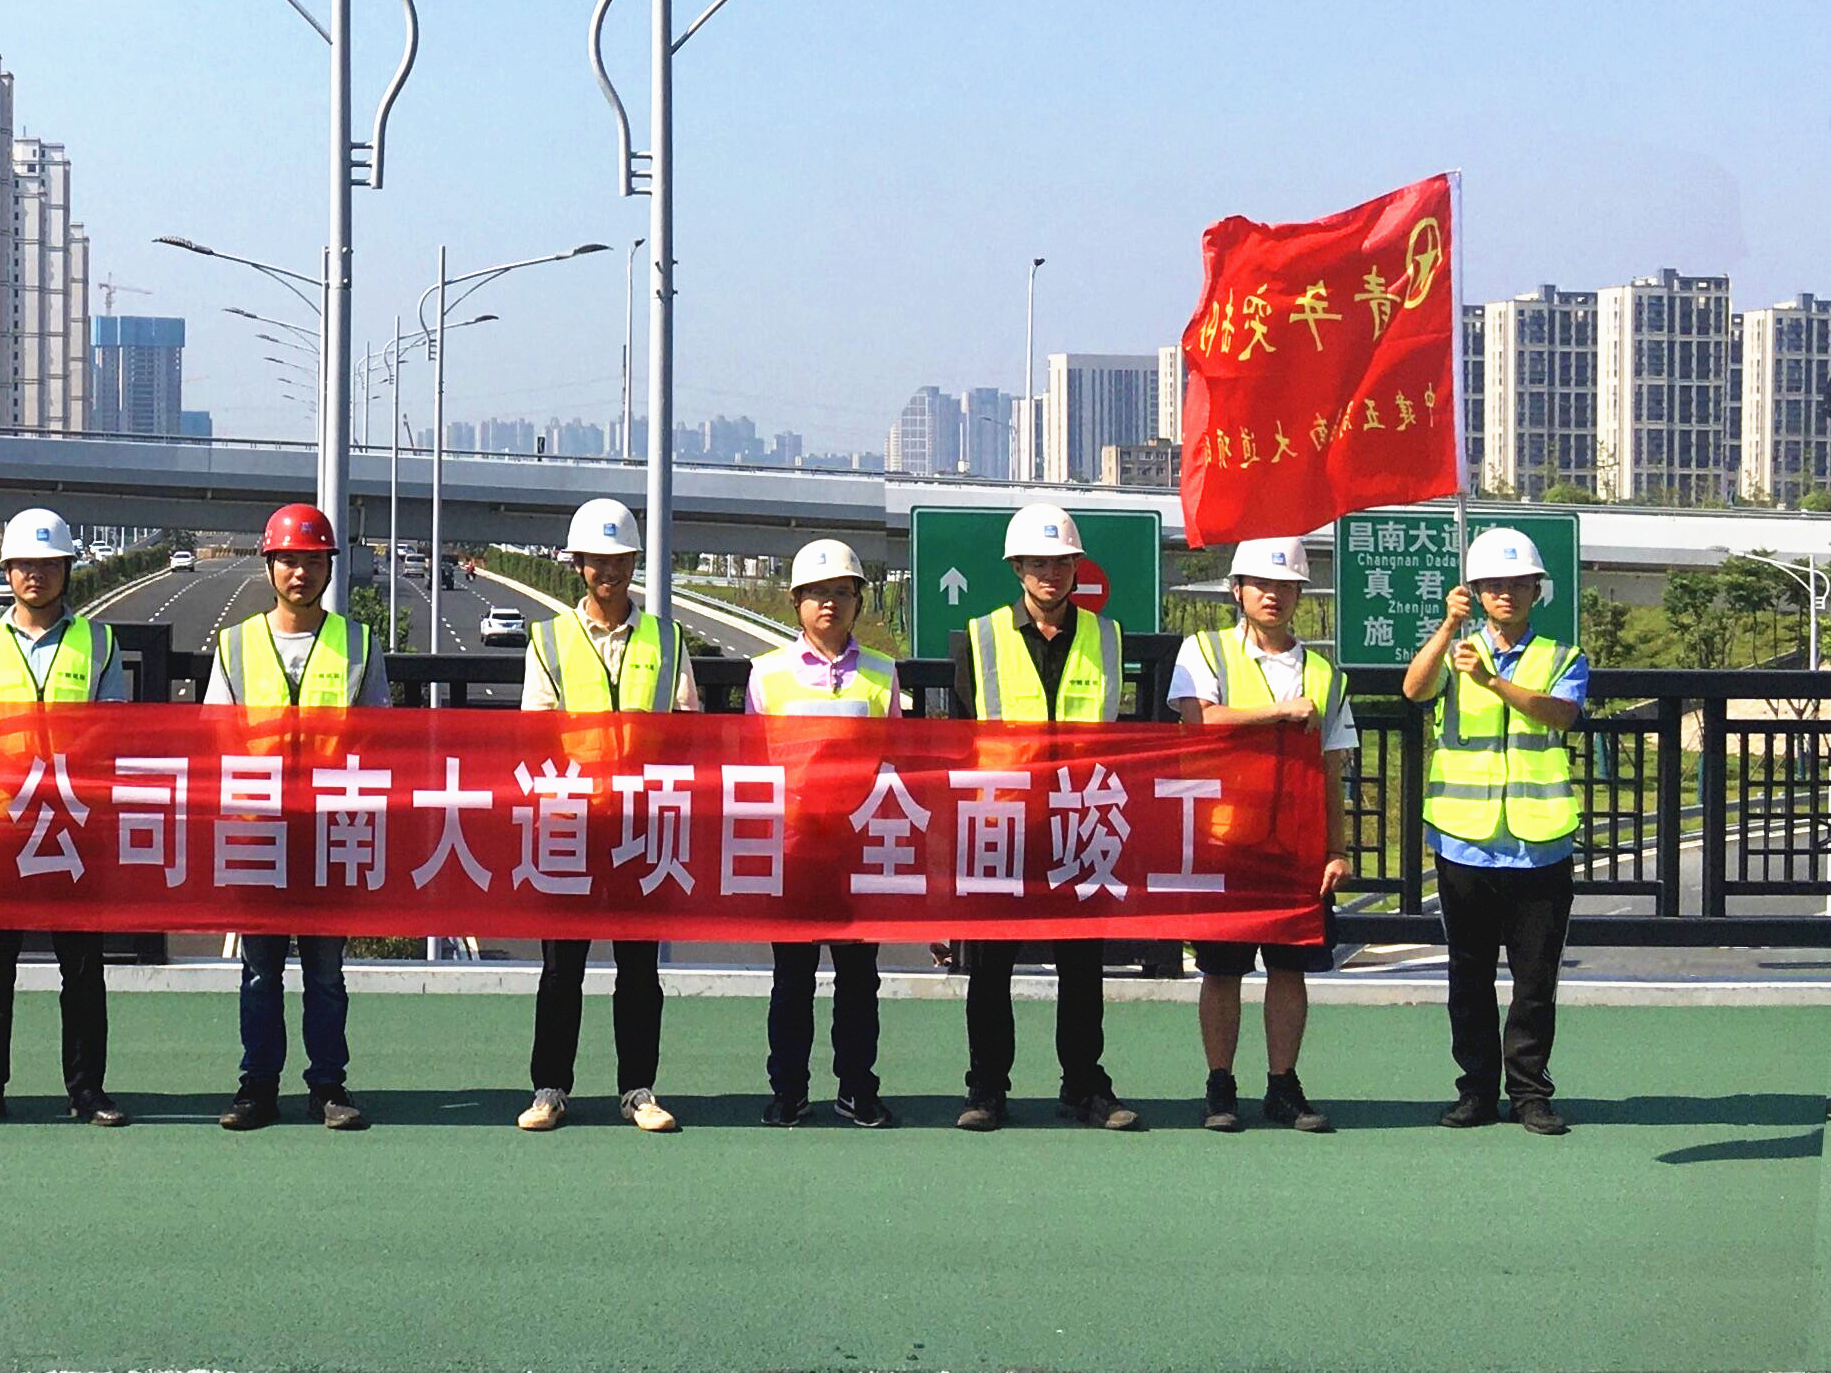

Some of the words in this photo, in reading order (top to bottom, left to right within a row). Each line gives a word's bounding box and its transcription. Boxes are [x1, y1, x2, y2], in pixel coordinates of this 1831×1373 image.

[1357, 553, 1420, 570] Changnan
[1387, 600, 1440, 617] Zhenjun
[848, 762, 1228, 902] 全面竣工
